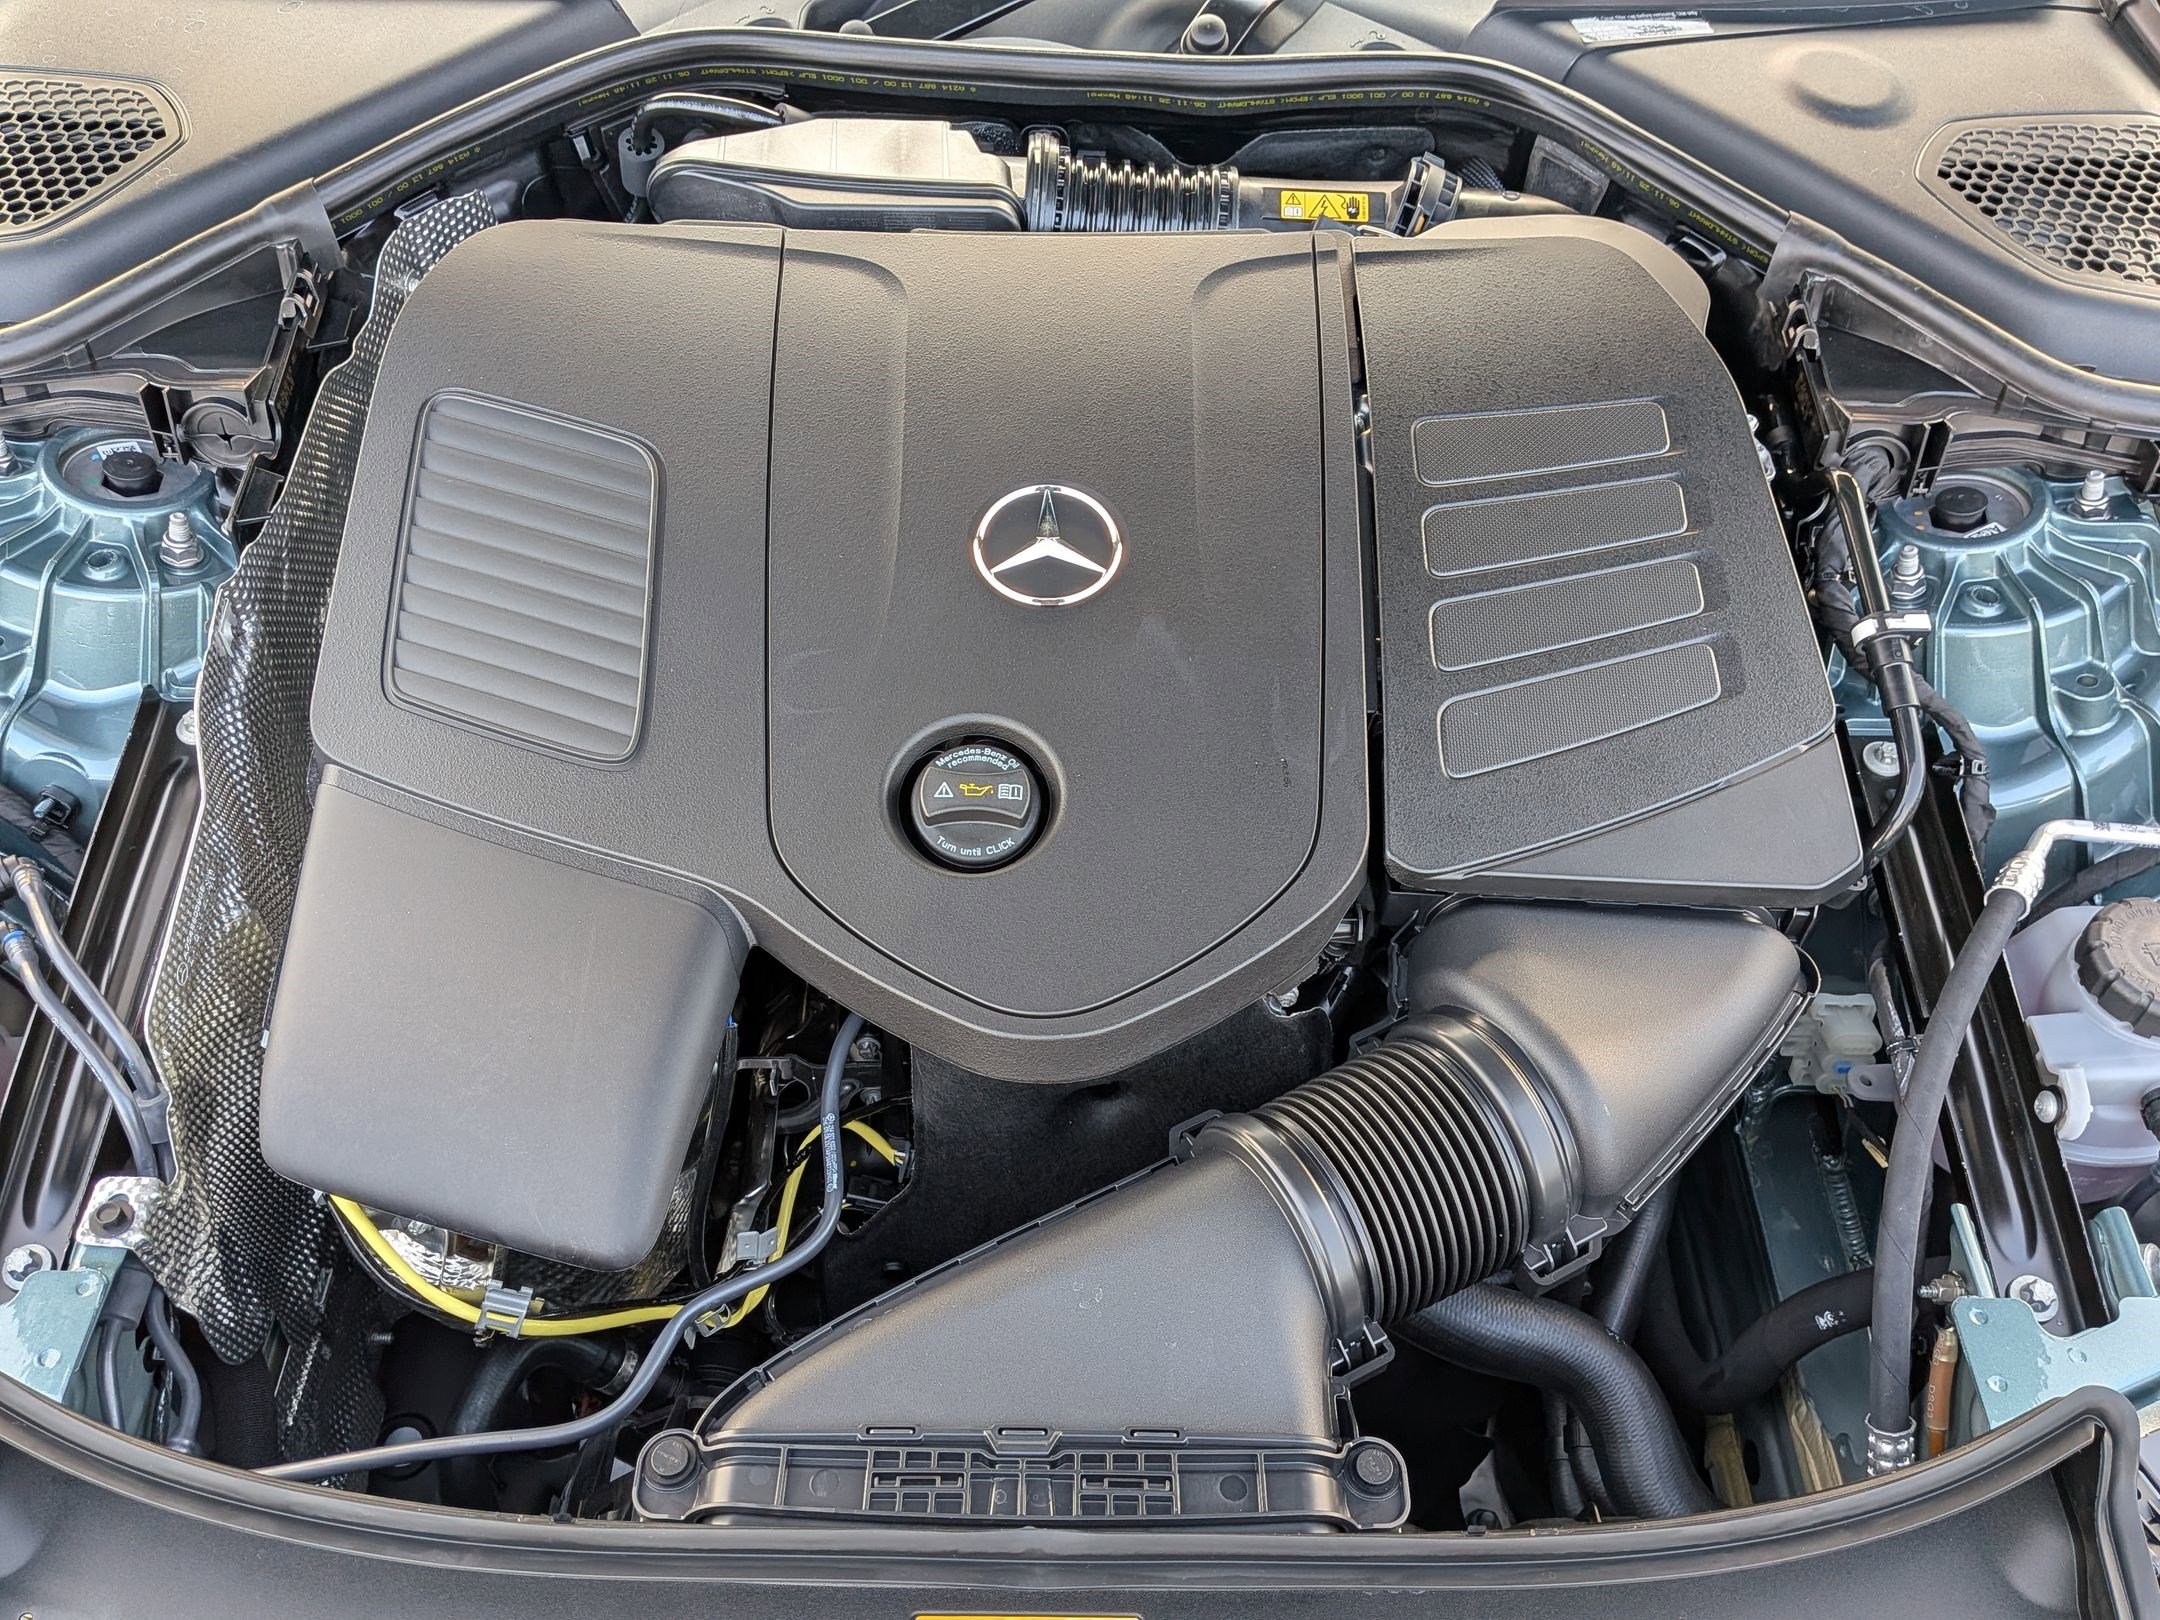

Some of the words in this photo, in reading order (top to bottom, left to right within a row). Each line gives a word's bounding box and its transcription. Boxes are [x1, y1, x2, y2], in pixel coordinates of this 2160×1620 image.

[935, 747, 1007, 767] Mercedes-Benz
[1008, 758, 1020, 769] Oil
[947, 755, 1009, 771] recommended
[937, 836, 957, 853] Turn
[960, 847, 982, 856] until
[986, 837, 1015, 855] CLICK
